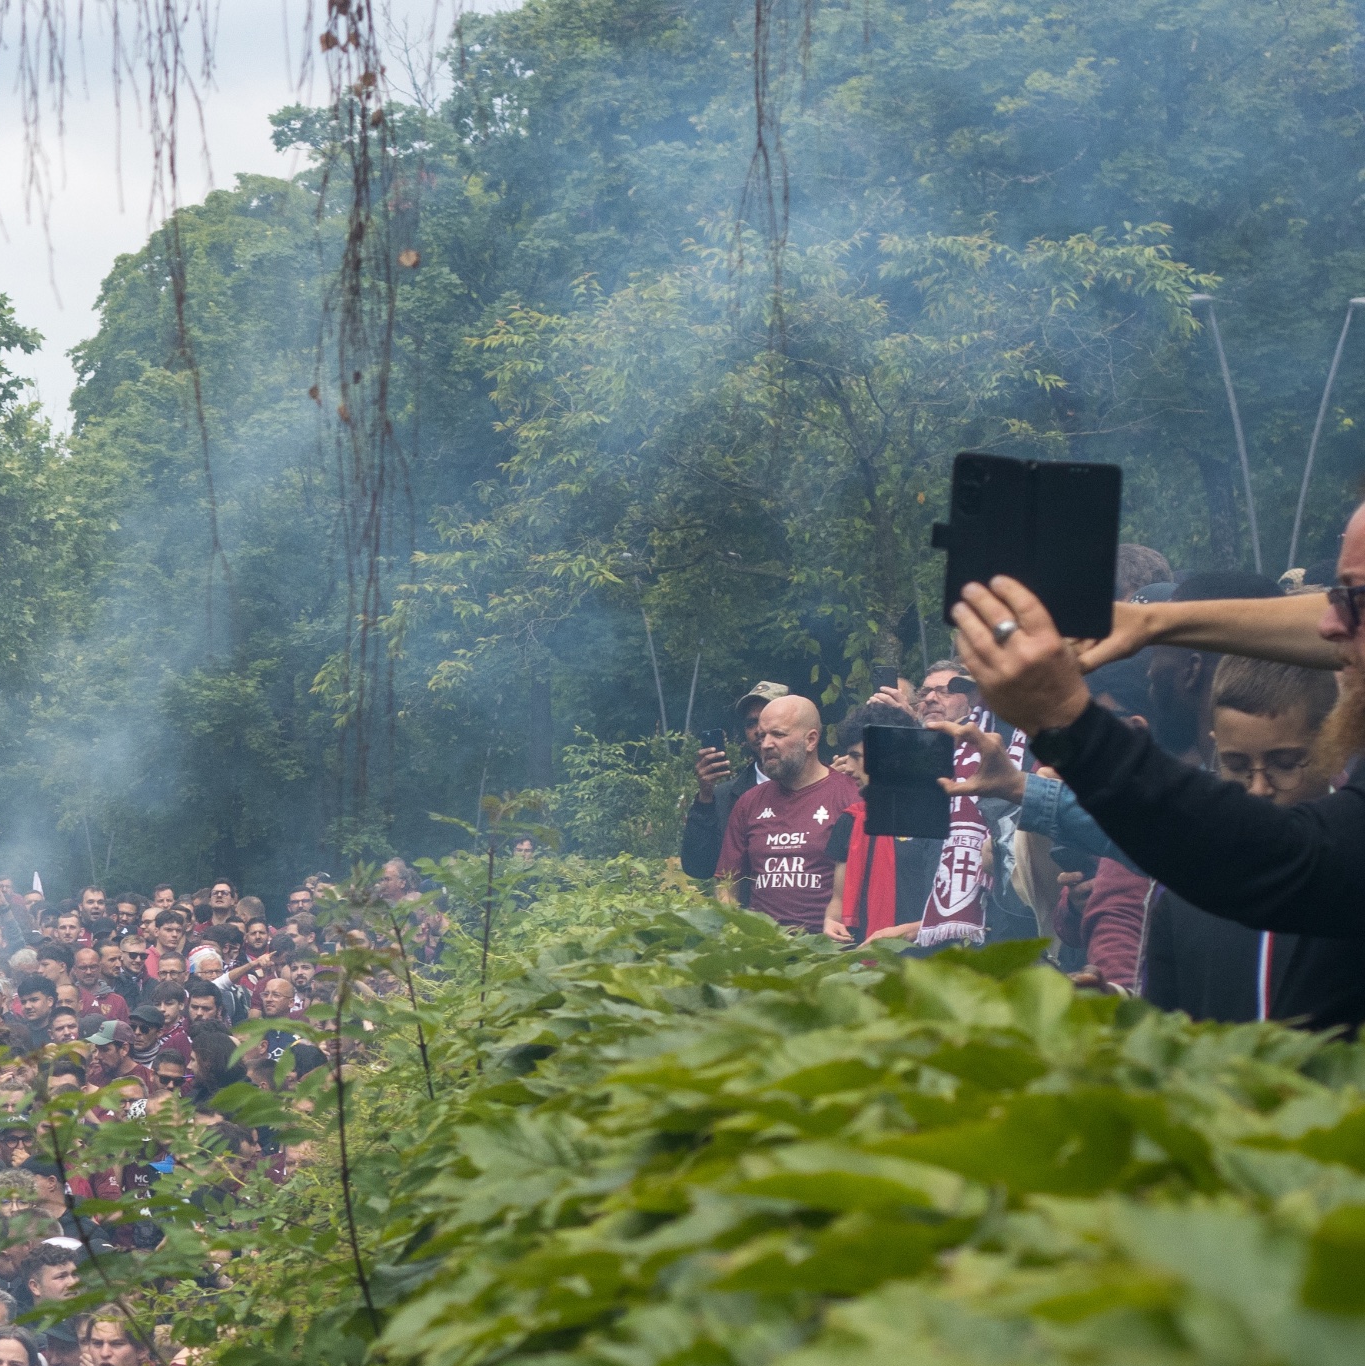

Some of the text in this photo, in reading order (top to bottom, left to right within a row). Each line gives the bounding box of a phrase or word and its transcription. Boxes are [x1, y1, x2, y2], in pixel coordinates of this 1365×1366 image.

[766, 832, 810, 846] MOSL
[952, 836, 982, 849] METZ
[764, 856, 806, 873] CAR
[756, 872, 823, 890] AVENUE
